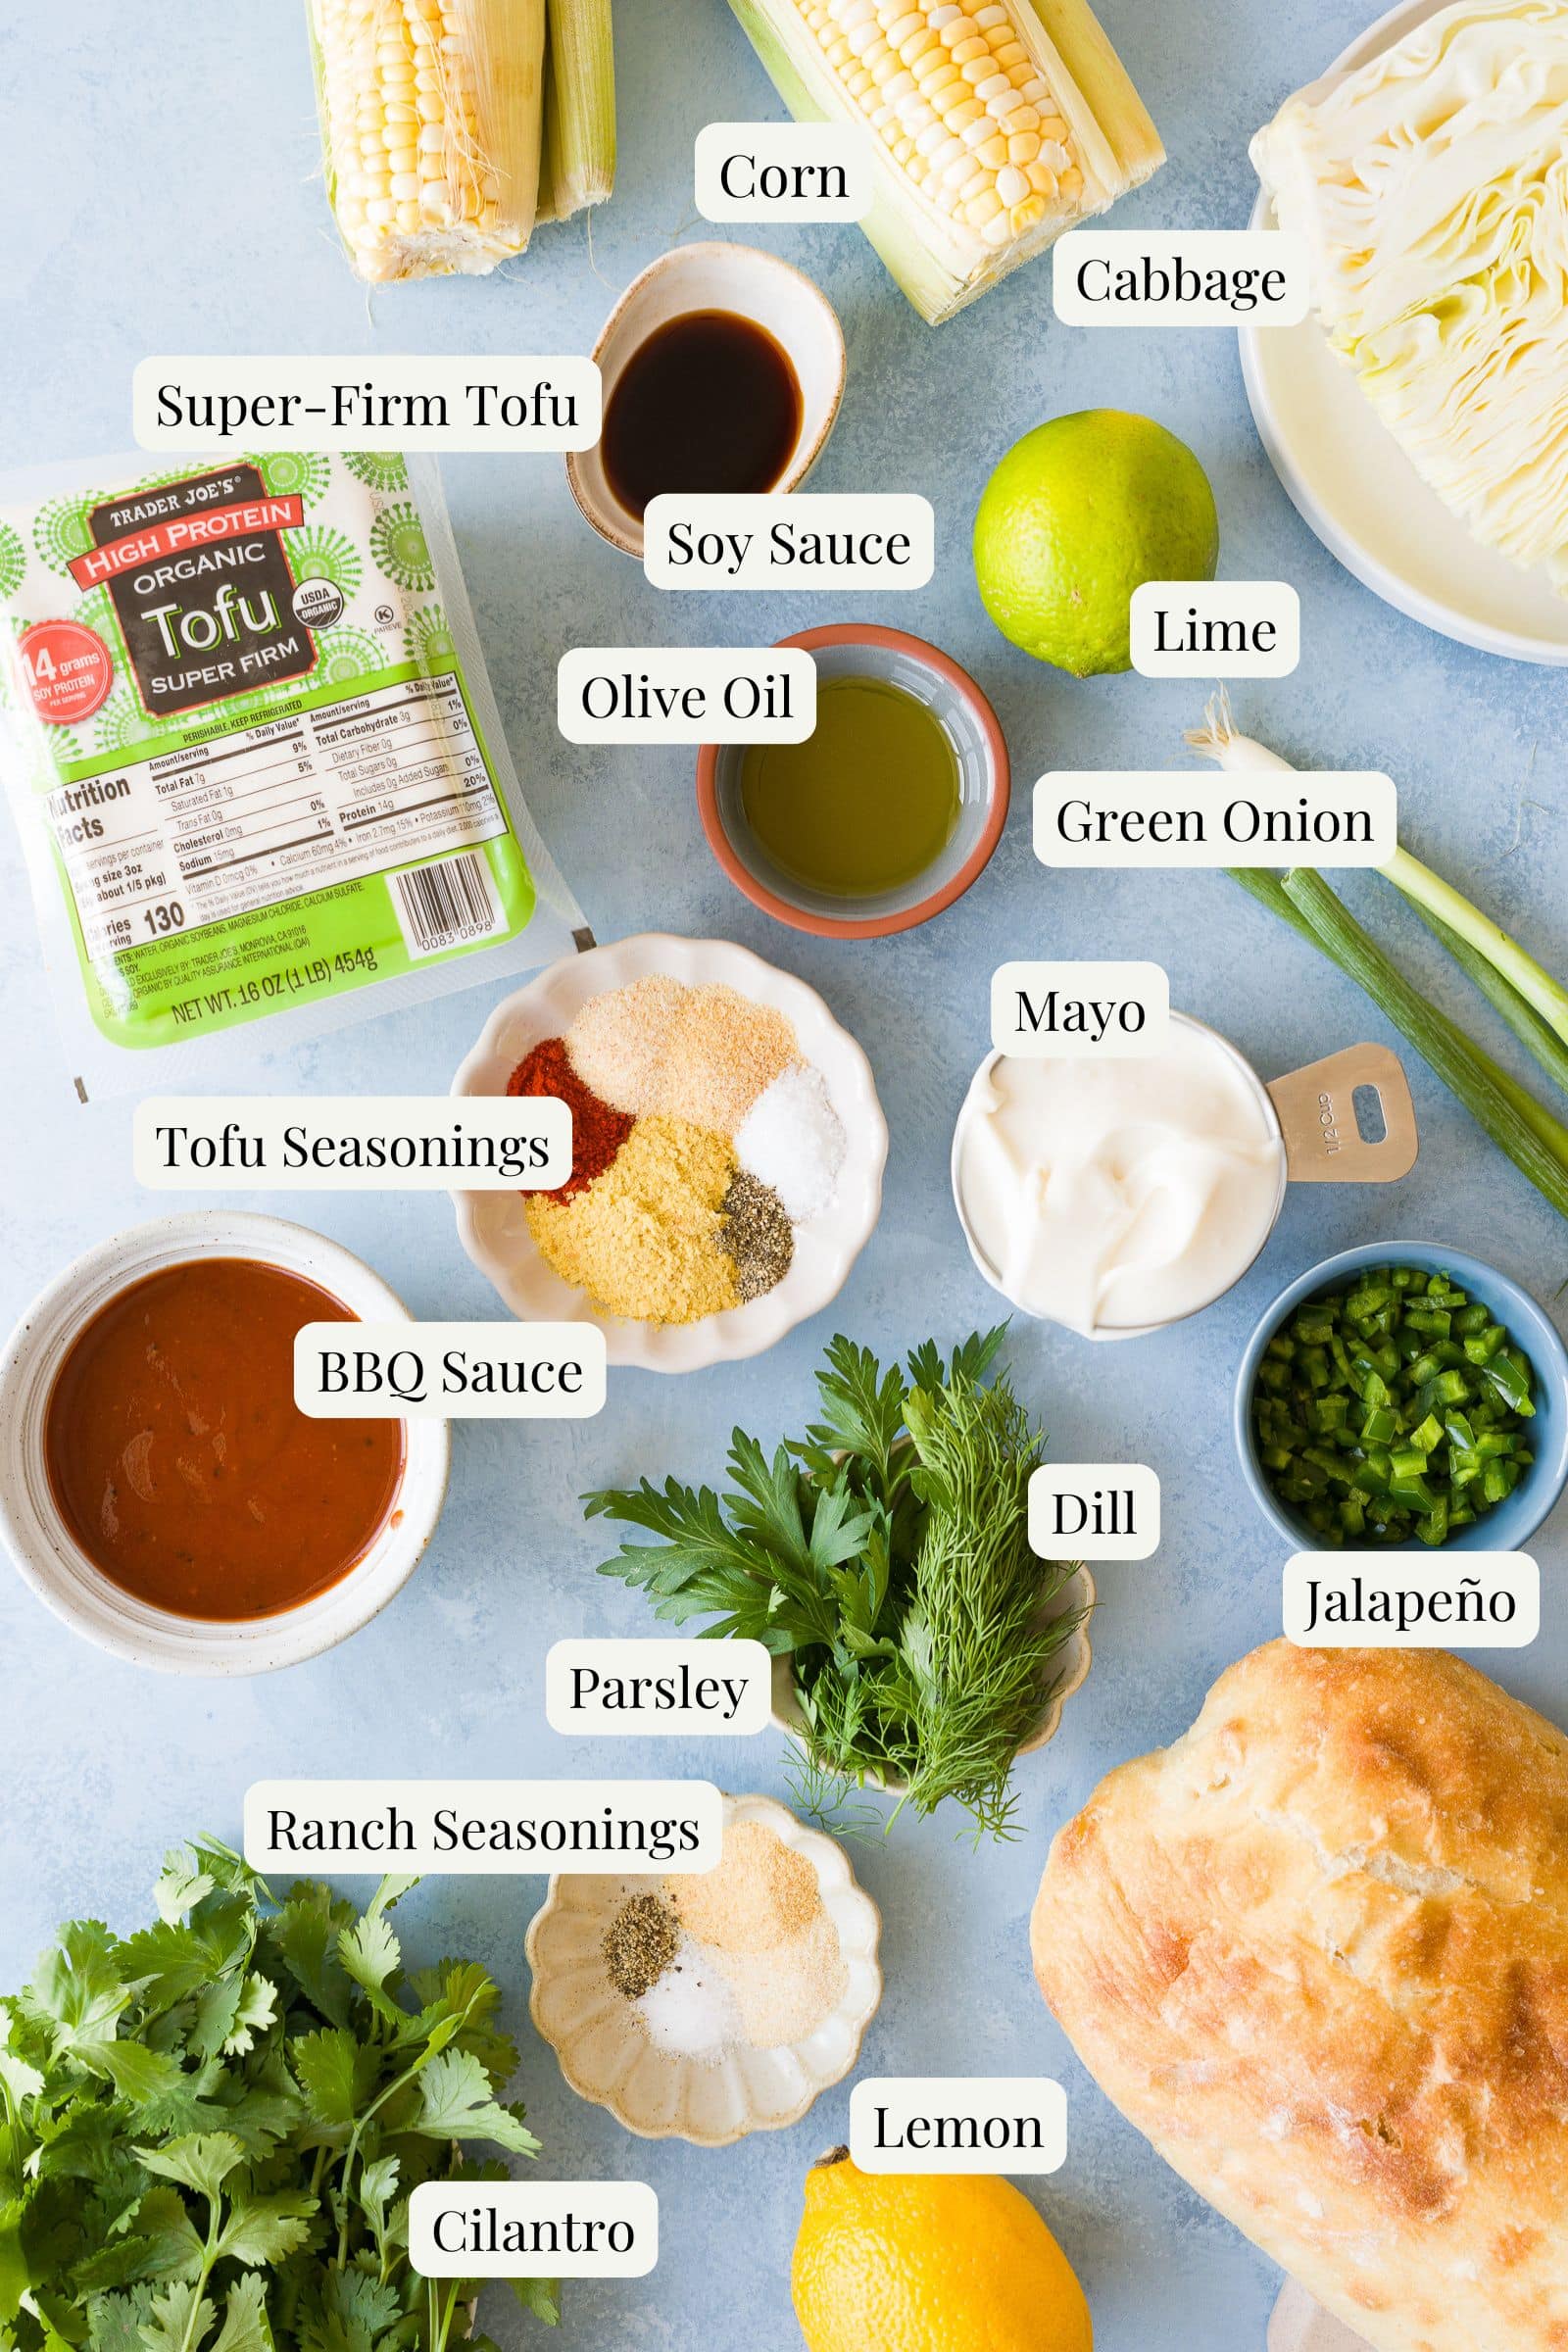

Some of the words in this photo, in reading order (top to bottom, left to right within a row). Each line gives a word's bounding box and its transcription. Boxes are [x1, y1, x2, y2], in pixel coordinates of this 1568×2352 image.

[111, 492, 180, 527] TRADER
[84, 536, 161, 580] HIGH
[165, 502, 292, 548] PROTEIN
[133, 543, 267, 595] ORGANIC
[301, 588, 330, 606] USDA
[301, 601, 338, 619] ORGANIC
[140, 584, 279, 658] Tofu
[60, 652, 100, 676] grams
[151, 661, 236, 695] SUPER
[241, 637, 299, 674] FIRM
[33, 686, 52, 702] SOY
[54, 674, 95, 696] PROTEIN
[310, 699, 370, 722] Amount/serving
[229, 715, 249, 728] KEEP
[249, 699, 302, 722] REFRIGERATED
[315, 731, 338, 746] Total
[339, 714, 398, 739] Carbohydrate
[398, 710, 411, 722] 3g
[447, 698, 462, 710] 1%
[148, 747, 209, 770] Amount/serving
[254, 725, 274, 738] Daily
[331, 748, 360, 763] Dietary
[360, 742, 380, 755] Fiber
[379, 737, 393, 750] 0g
[452, 717, 467, 730] 0%
[155, 780, 177, 795] Total
[178, 775, 193, 787] Fat
[194, 772, 206, 784] 7g
[291, 740, 307, 753] 9%
[171, 792, 209, 811] Saturated
[208, 788, 222, 800] Fat
[222, 785, 233, 797] 1g
[297, 760, 313, 772] 5%
[338, 767, 358, 781] Total
[357, 760, 386, 776] Sugars
[385, 756, 398, 768] 0g
[352, 781, 386, 798] Includes
[385, 777, 398, 789] 0g
[397, 768, 423, 784] Added
[422, 763, 449, 777] Sugars
[465, 754, 479, 766] 0%
[176, 817, 198, 830] Trans
[197, 812, 211, 824] Fat
[210, 808, 223, 821] 0g
[338, 805, 376, 822] Protein
[377, 799, 394, 810] 14g
[463, 772, 486, 788] 20%
[172, 829, 223, 853] Cholesterol
[310, 799, 324, 811] 0%
[178, 855, 212, 871] Sodium
[317, 816, 330, 829] 1%
[117, 850, 129, 861] per
[129, 839, 164, 857] container
[185, 879, 212, 895] Vitamin
[279, 849, 311, 865] Calcium
[310, 842, 334, 857] 60mg
[355, 831, 371, 843] Iron
[418, 805, 460, 822] Potassium
[97, 884, 123, 902] about
[125, 878, 142, 893] 1/5
[144, 871, 167, 889] pkg)
[101, 869, 122, 883] size
[123, 863, 142, 876] 3oz
[144, 901, 184, 934] 130
[158, 935, 190, 953] ORGANIC
[227, 910, 268, 930] MAGNESIUM
[303, 890, 334, 907] CALCIUM
[421, 932, 456, 952] 0083
[460, 919, 493, 941] 0898
[123, 962, 140, 975] SOY.
[132, 980, 164, 998] ORGANIC
[163, 978, 172, 989] BY
[172, 969, 201, 986] QUALITY
[201, 956, 242, 976] ASSURANCE
[241, 942, 292, 963] INTERNATIONAL
[135, 964, 178, 984] EXCLUSIVELY
[179, 960, 189, 970] BY
[190, 952, 219, 967] TRADER
[276, 930, 287, 941] CA
[286, 924, 307, 938] 91016
[171, 997, 203, 1024] NET
[203, 988, 236, 1013] WT.
[237, 981, 260, 1005] 16
[261, 973, 285, 997] OZ
[284, 967, 305, 992] (1
[304, 957, 331, 984] LB)
[334, 947, 377, 972] 454g
